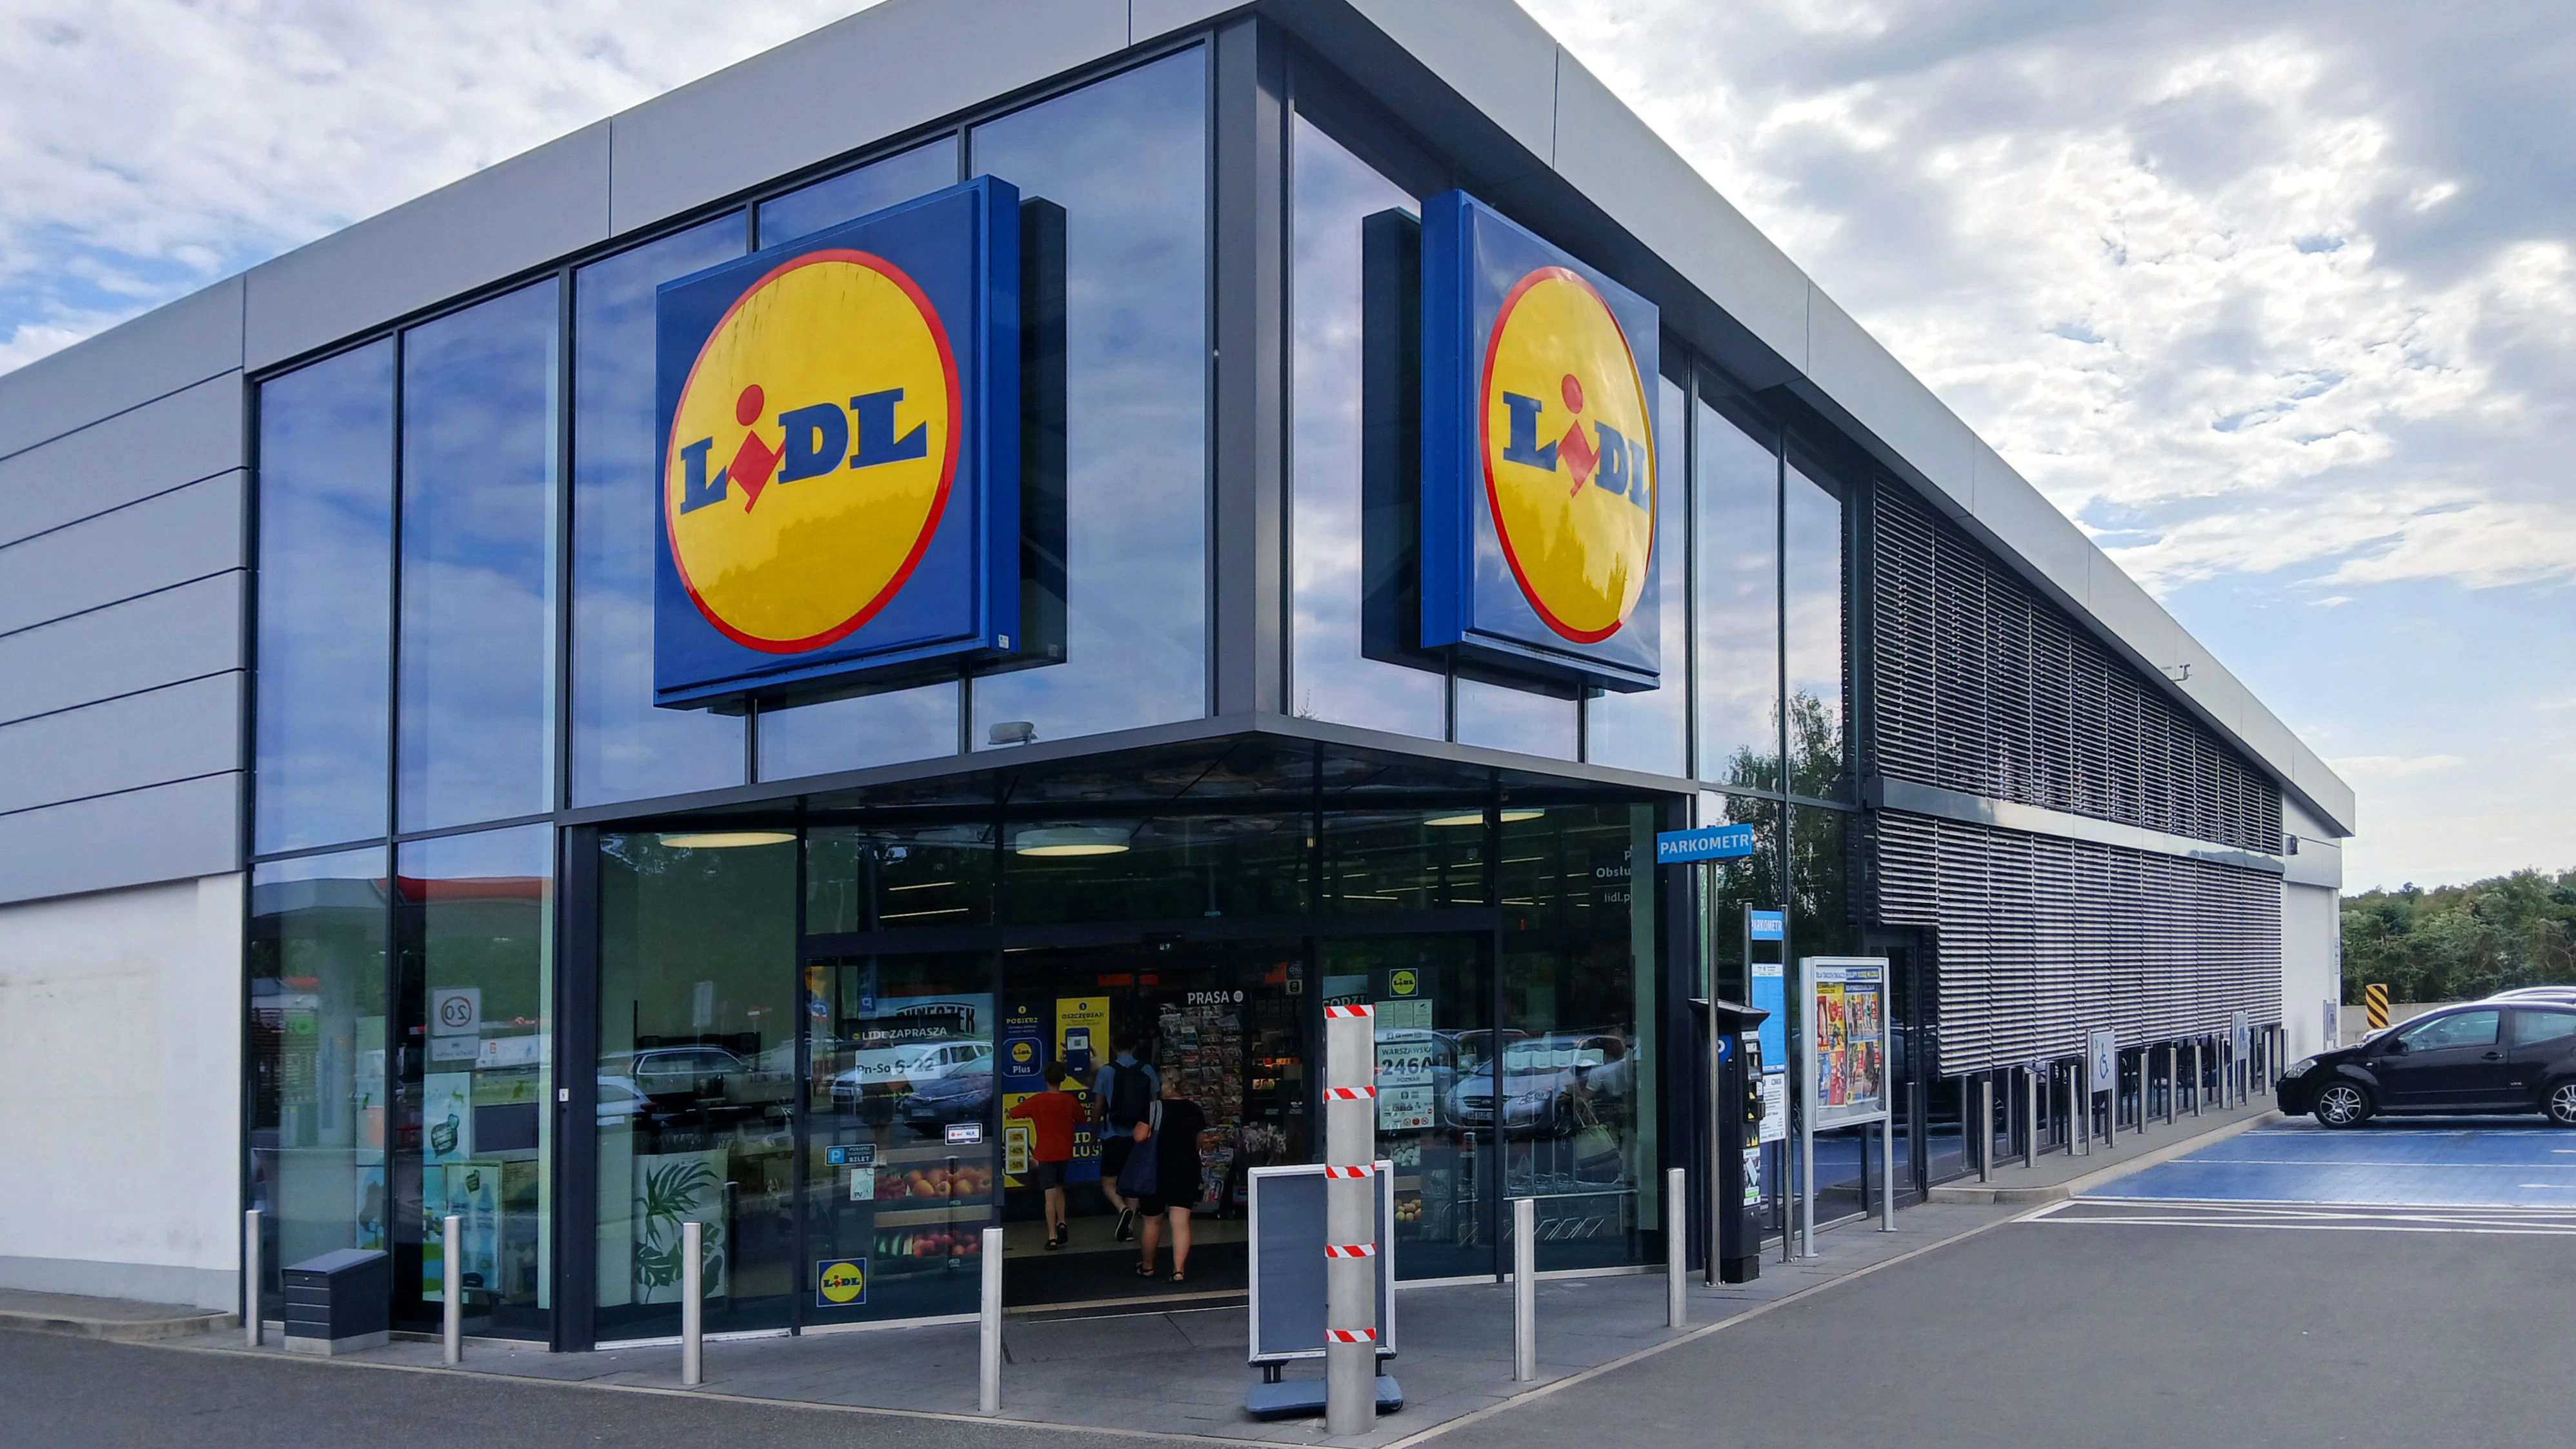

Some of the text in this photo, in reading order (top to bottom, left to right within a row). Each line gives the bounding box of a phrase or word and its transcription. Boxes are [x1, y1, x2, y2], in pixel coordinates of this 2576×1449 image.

[1660, 833, 1749, 855] PARKOMETR
[1187, 991, 1229, 1005] PRASA
[889, 1027, 947, 1039] ZAPRASZA
[1012, 1065, 1031, 1074] Plus
[1382, 1057, 1434, 1076] 246A
[1072, 1144, 1103, 1158] LUS!
